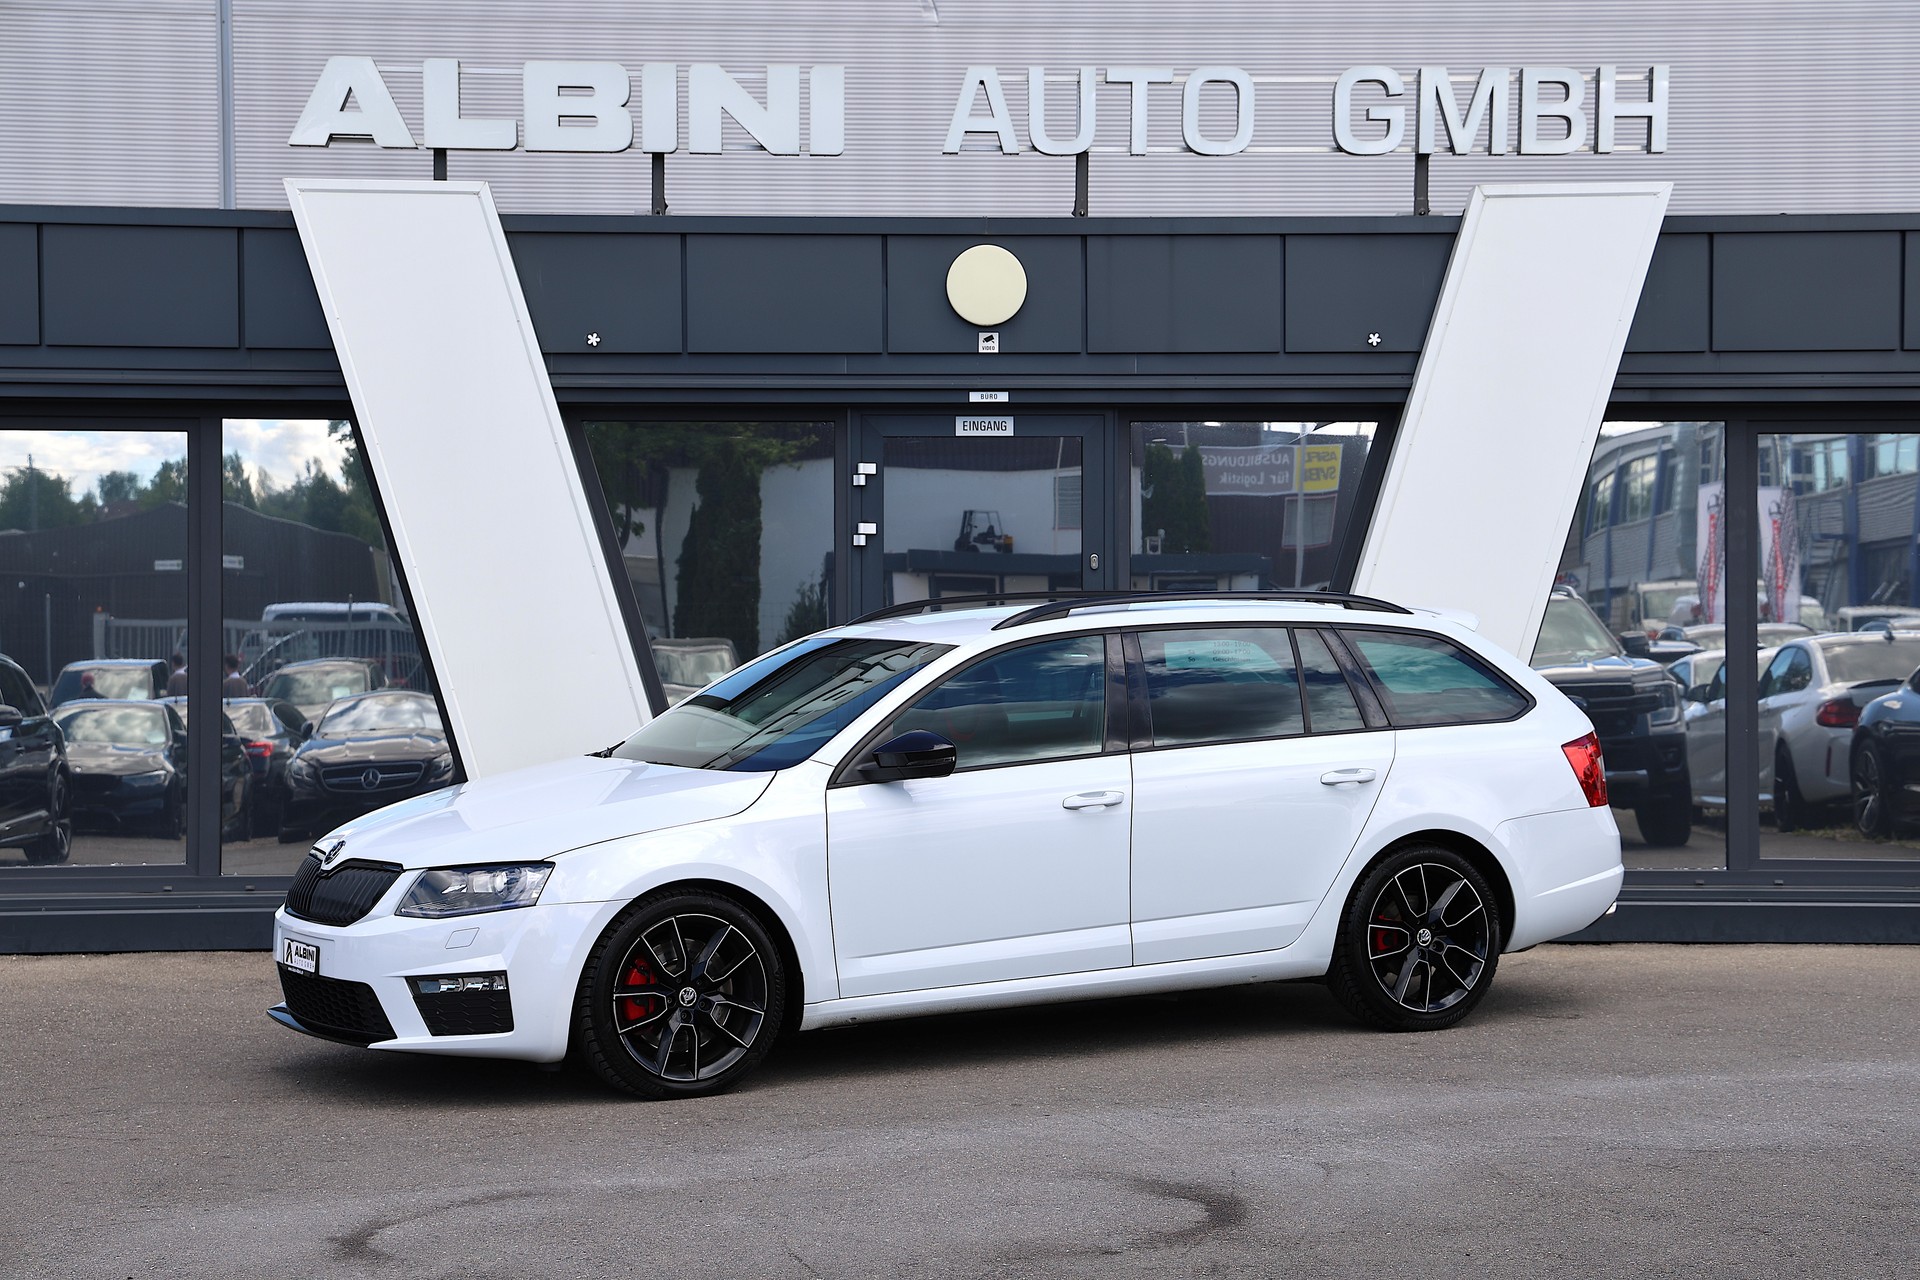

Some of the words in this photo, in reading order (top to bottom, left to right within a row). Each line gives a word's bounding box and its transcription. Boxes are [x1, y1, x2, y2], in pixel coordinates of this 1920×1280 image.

[288, 56, 845, 156] ALBINI
[942, 65, 1256, 157] AUTO
[1331, 64, 1670, 157] GMBH
[962, 420, 1007, 432] EINGANG
[294, 945, 315, 962] ALBINI
